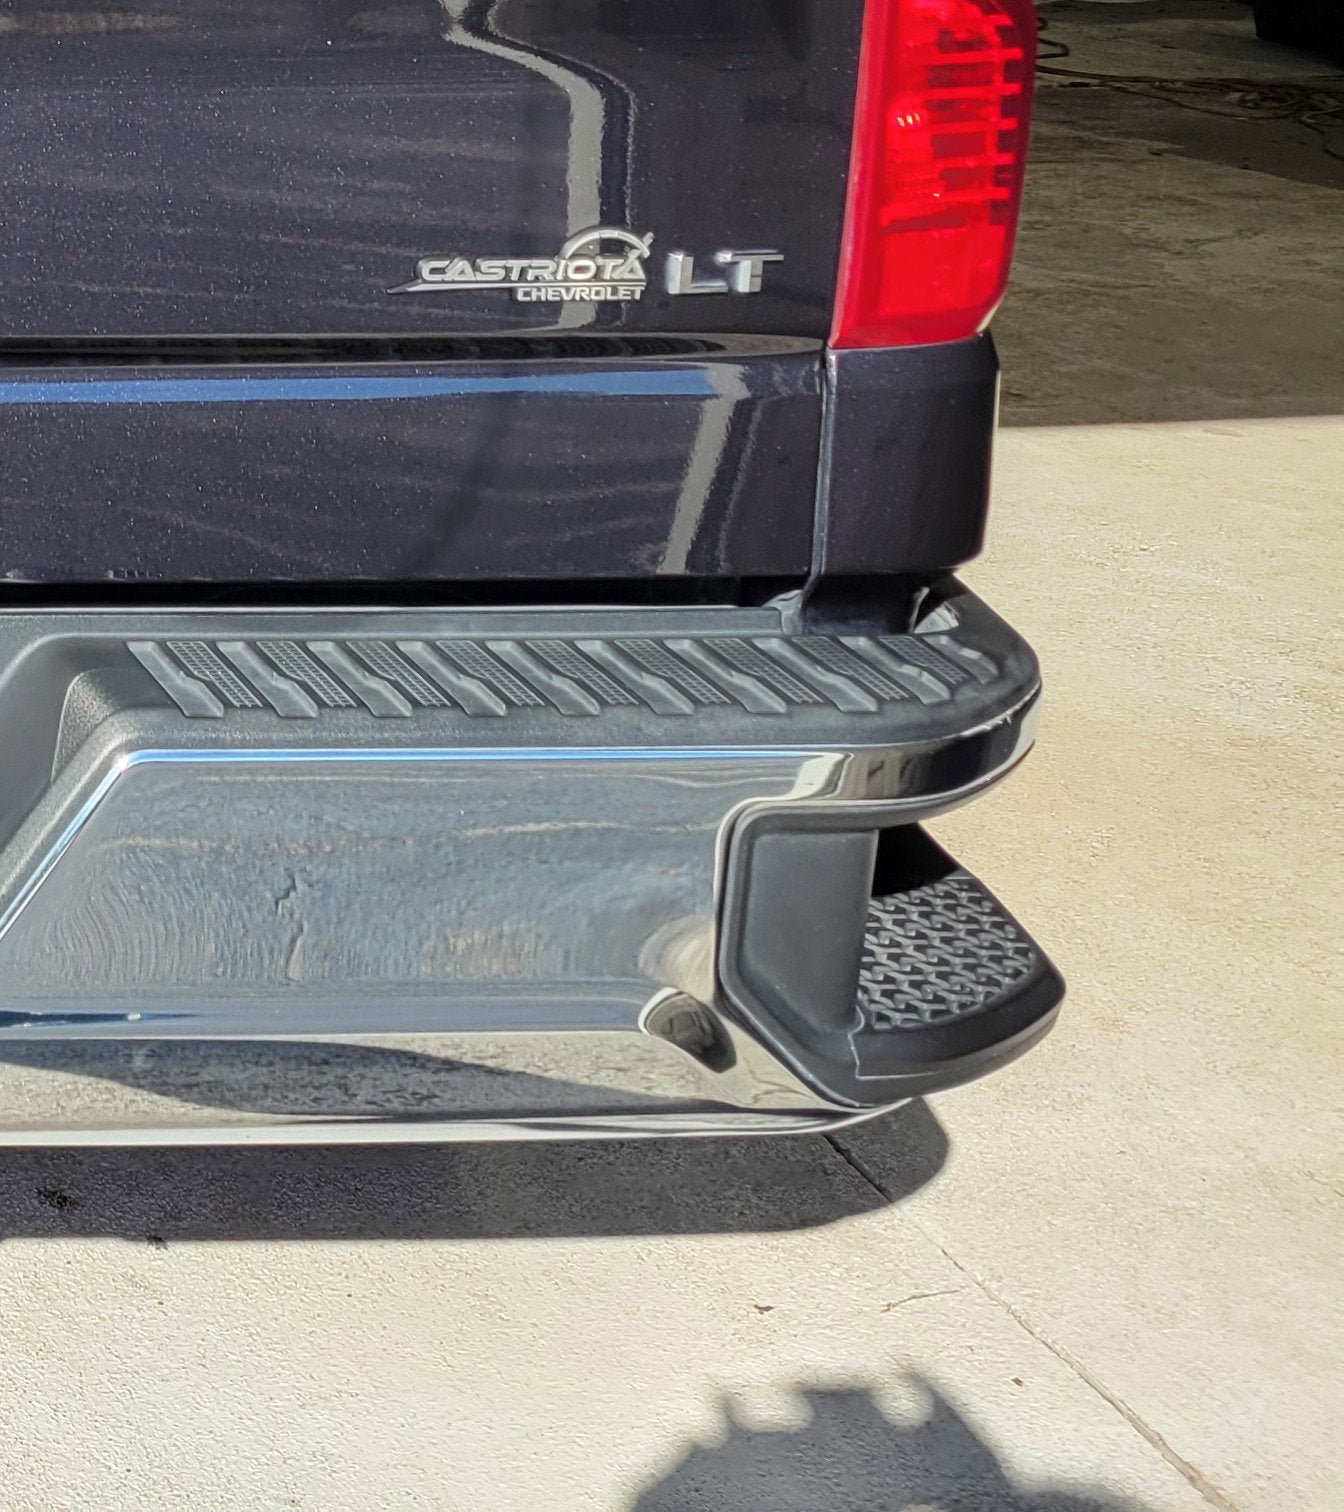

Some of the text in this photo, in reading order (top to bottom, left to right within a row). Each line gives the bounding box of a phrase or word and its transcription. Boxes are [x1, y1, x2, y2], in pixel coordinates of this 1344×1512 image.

[419, 255, 647, 281] CASTRIOTA
[666, 250, 785, 294] LT
[516, 285, 644, 302] CHEVROLET
